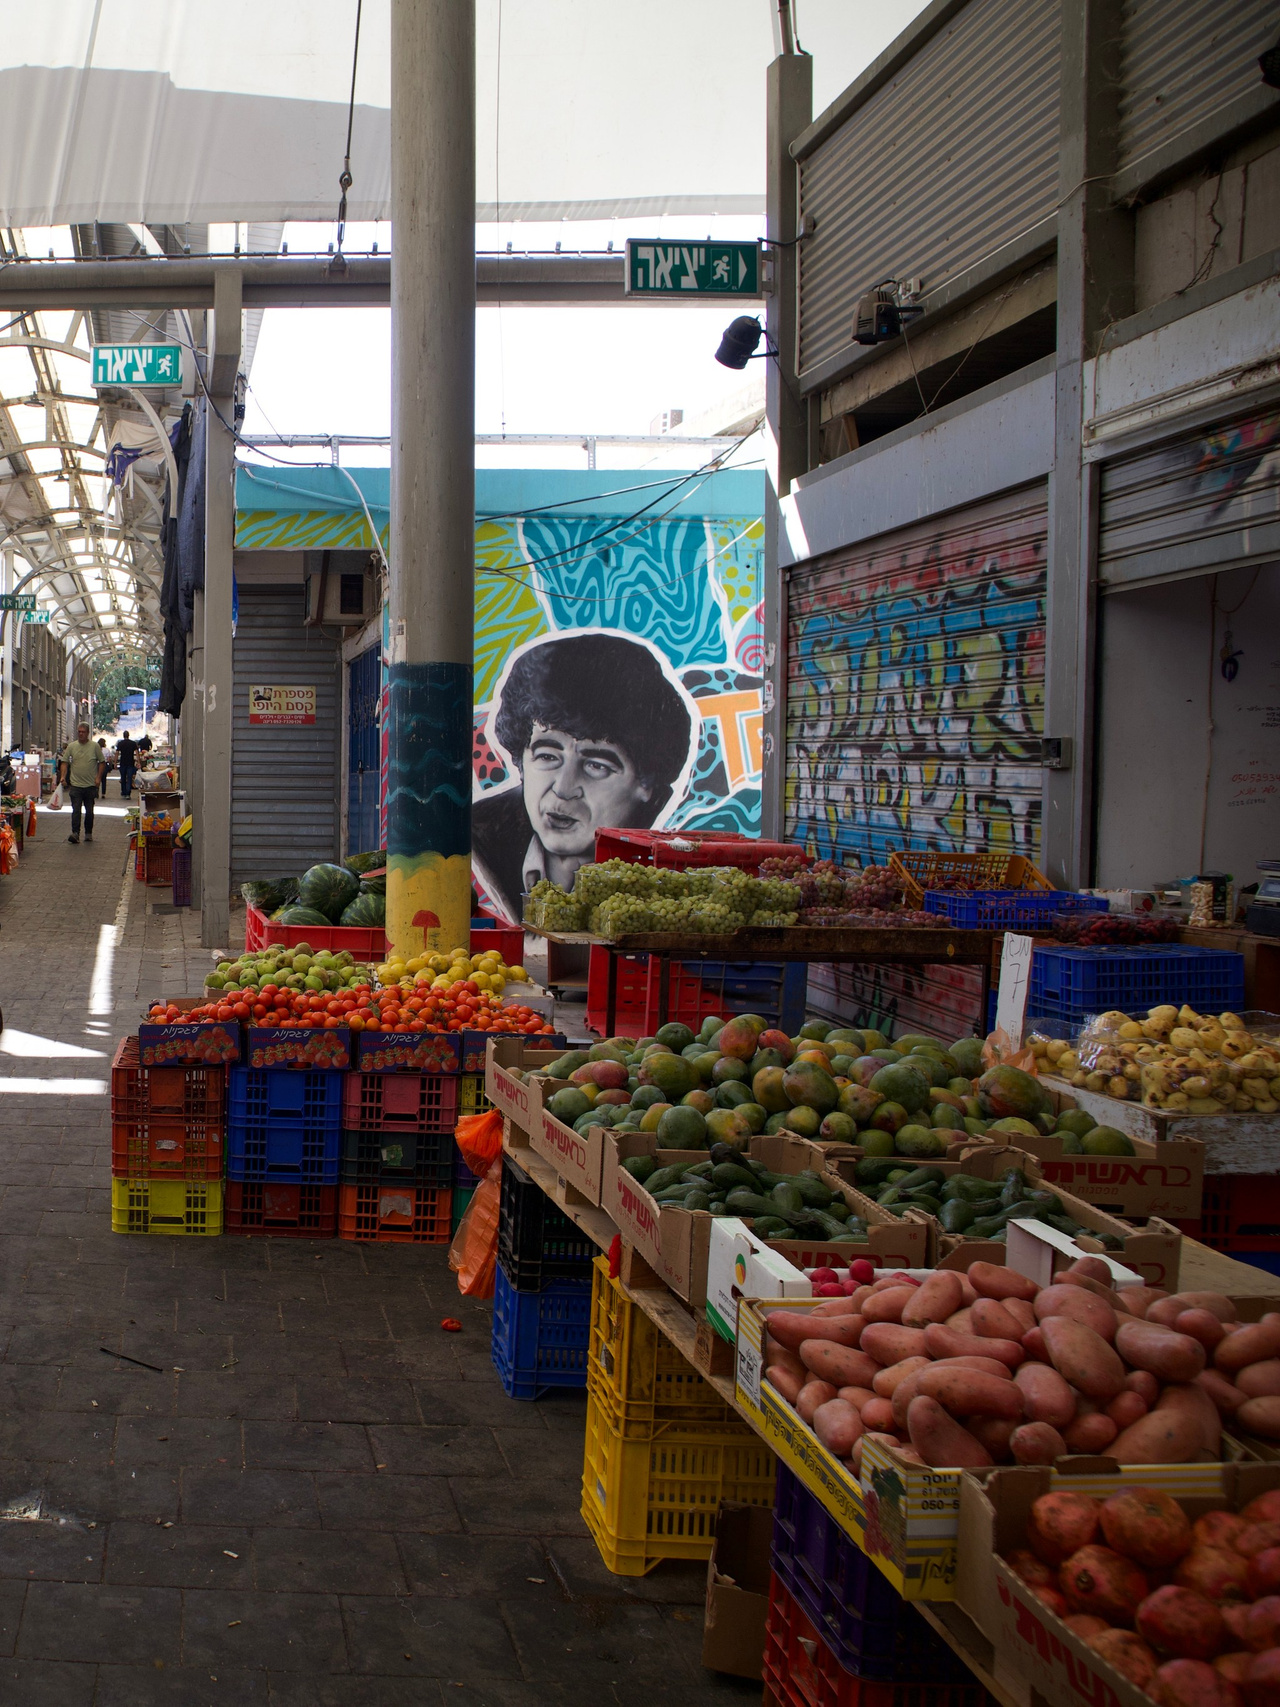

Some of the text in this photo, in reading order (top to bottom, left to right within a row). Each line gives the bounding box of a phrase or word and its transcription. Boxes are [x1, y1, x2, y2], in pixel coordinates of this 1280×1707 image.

[637, 246, 706, 289] יציאה
[98, 348, 153, 382] יציאה
[273, 690, 314, 699] מספרת
[252, 702, 314, 714] קסם היופי
[1010, 963, 1025, 1003] 7
[160, 1026, 200, 1038] עגבניות
[271, 1029, 312, 1041] עגבניות
[381, 1033, 422, 1045] עגבניות
[496, 1073, 529, 1113] בראשית
[546, 1122, 586, 1170] בראשית
[1040, 1161, 1192, 1187] בראשית
[1077, 1186, 1119, 1195] מפסגות
[923, 1475, 952, 1486] יוסף
[936, 1487, 958, 1498] משק
